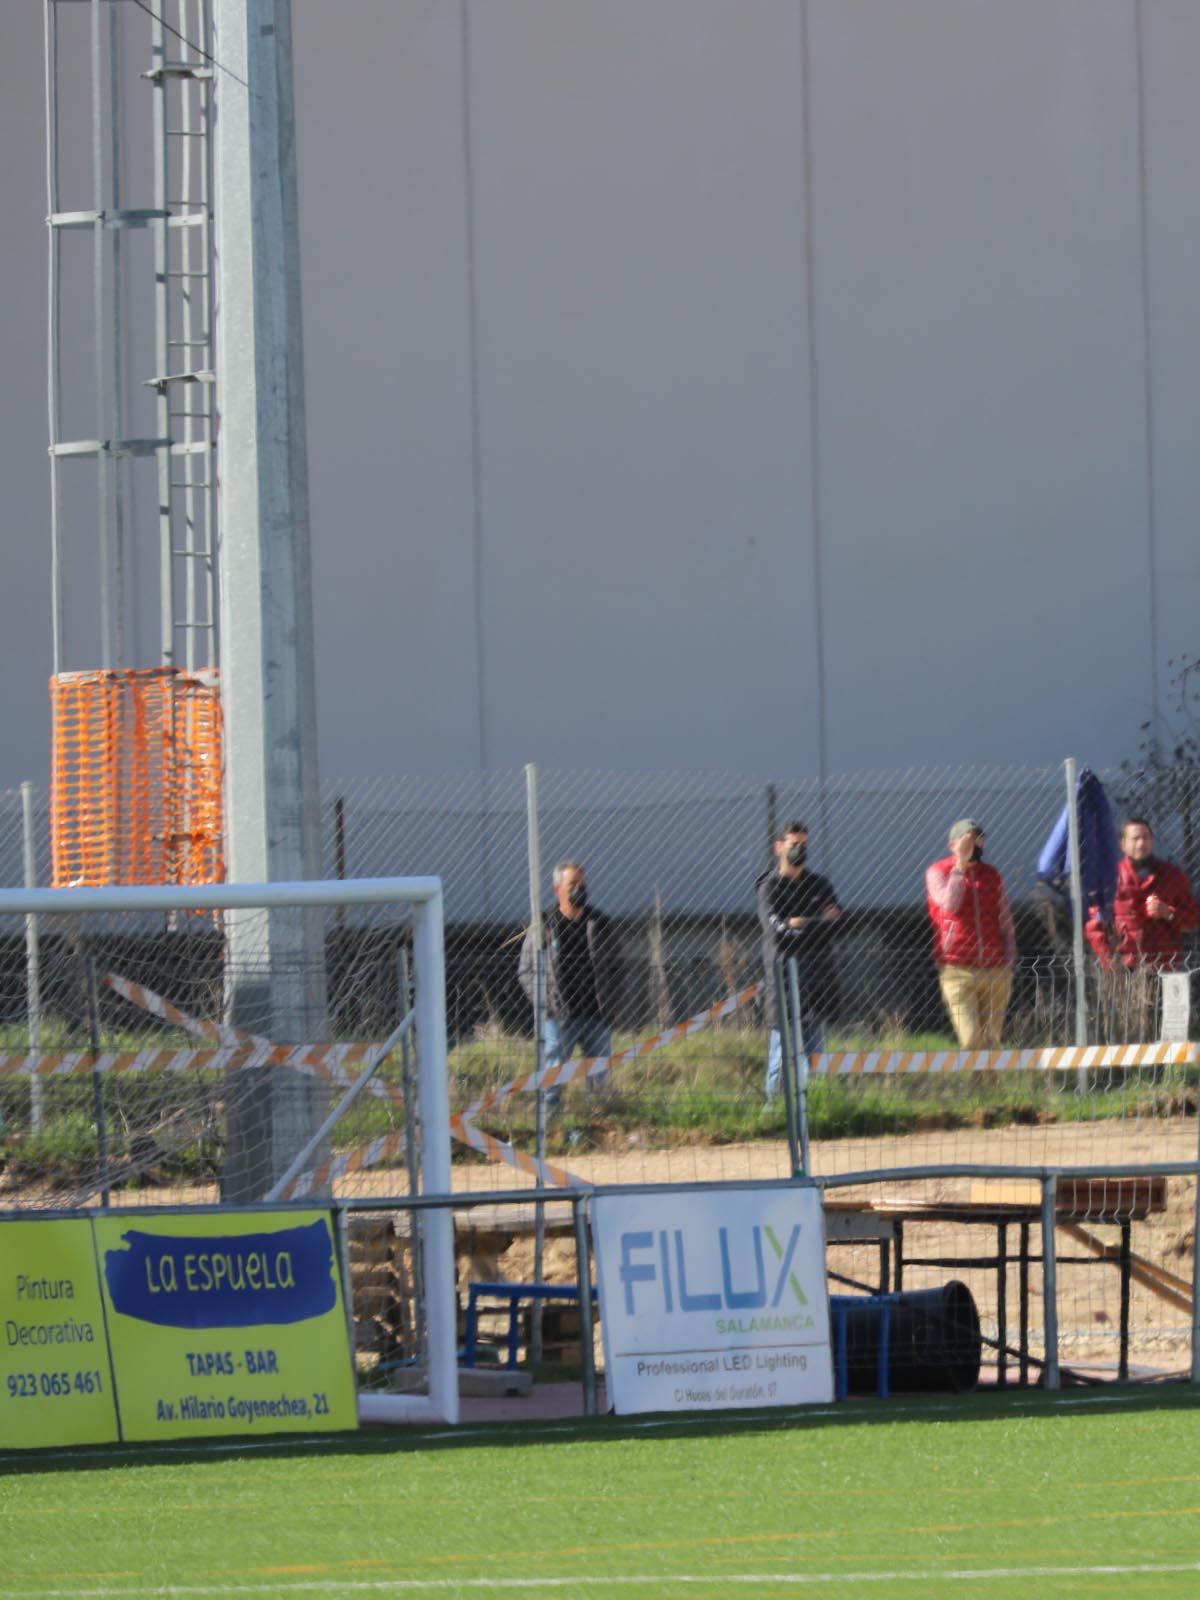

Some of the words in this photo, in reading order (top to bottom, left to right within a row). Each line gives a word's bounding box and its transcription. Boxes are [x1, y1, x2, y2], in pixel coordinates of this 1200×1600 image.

[620, 1223, 807, 1315] FILLUX
[16, 1274, 75, 1299] Pintura
[5, 1318, 95, 1346] Decorativa
[716, 1315, 815, 1334] SALAMANCA
[186, 1352, 234, 1376] TAPAS
[245, 1350, 279, 1374] BAR
[636, 1359, 719, 1376] Professional
[722, 1355, 753, 1371] LED
[756, 1353, 808, 1371] Lighting
[6, 1373, 38, 1397] 923
[40, 1371, 71, 1396] 065
[74, 1370, 103, 1394] 461
[156, 1400, 179, 1420] Av.
[180, 1395, 225, 1419] Hilario
[313, 1392, 330, 1415] 21
